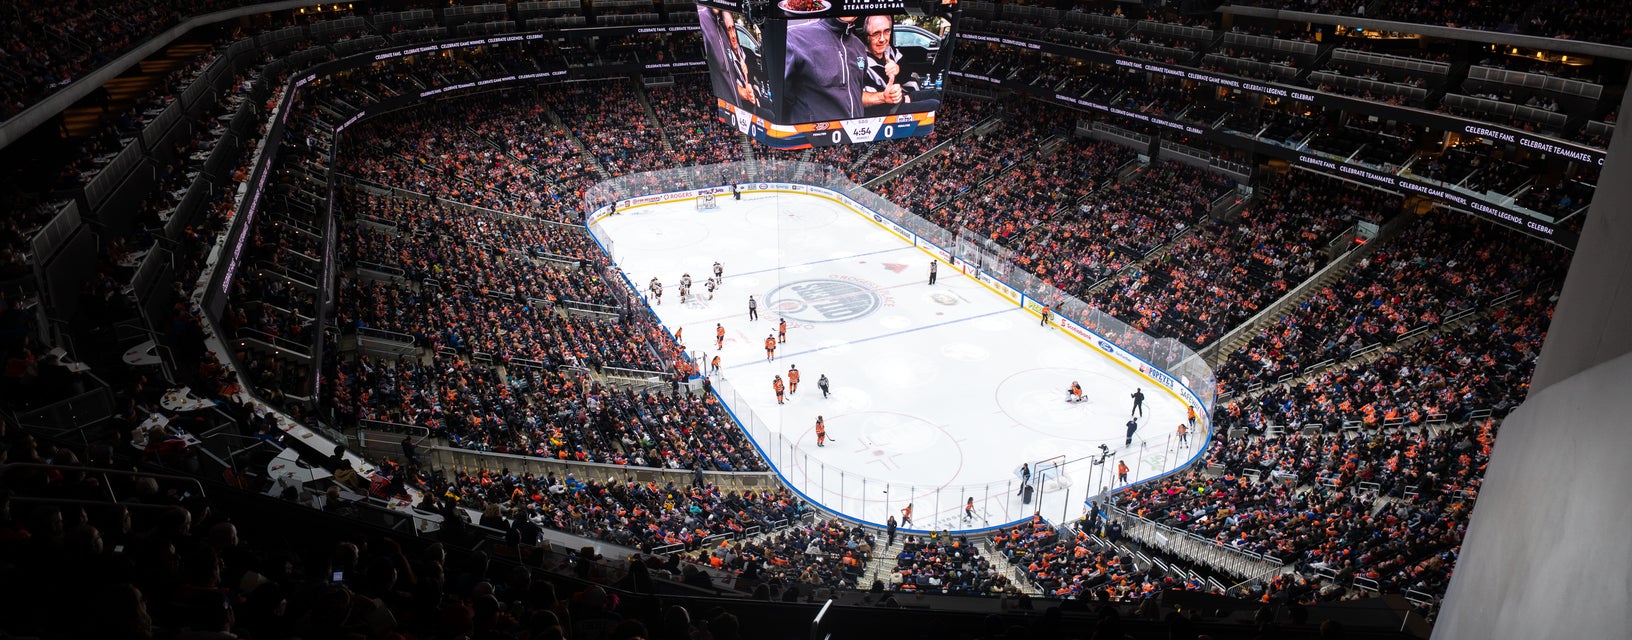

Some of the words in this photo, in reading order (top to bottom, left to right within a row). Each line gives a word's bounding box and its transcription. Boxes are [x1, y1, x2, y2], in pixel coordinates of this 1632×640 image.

[832, 130, 841, 143] 0
[853, 127, 871, 136] 4:54
[884, 125, 894, 138] 0
[1465, 126, 1499, 138] CELEBRATE
[1499, 133, 1515, 142] FANS.
[1520, 138, 1553, 152] CELEBRATE
[1553, 147, 1591, 162] TEAMMATES.
[1299, 156, 1323, 166] CELEBRATE
[1339, 166, 1365, 177] CELEBRATE
[1366, 172, 1395, 184] TEAMMATES.
[1399, 181, 1428, 193] CELEBRATE
[1428, 189, 1444, 197] GAME
[1444, 193, 1467, 205] WINNERS.
[1470, 202, 1498, 215] CELEBRATE
[1498, 212, 1523, 224] LEGENDS.
[1067, 323, 1092, 340] Scotiabank
[1180, 388, 1201, 409] SAFEWAY
